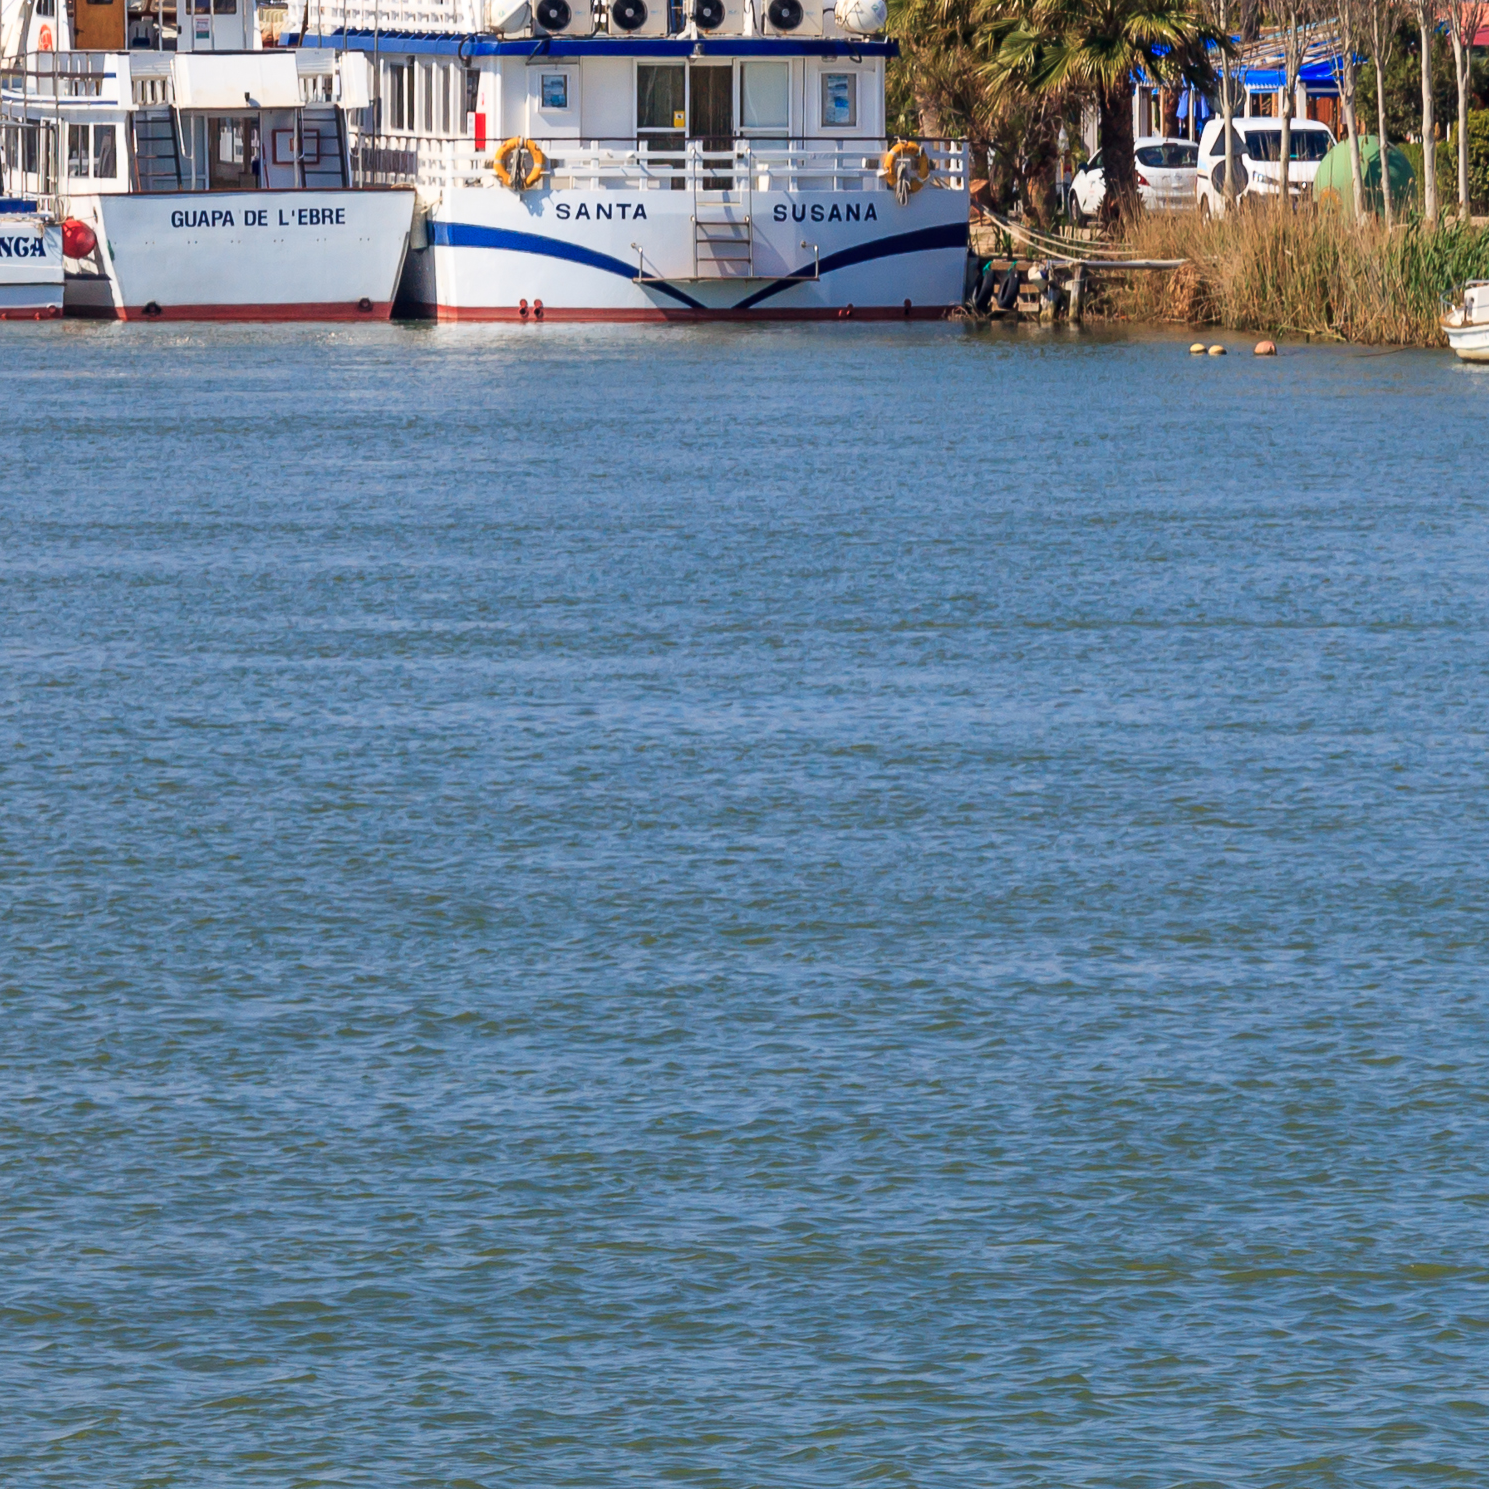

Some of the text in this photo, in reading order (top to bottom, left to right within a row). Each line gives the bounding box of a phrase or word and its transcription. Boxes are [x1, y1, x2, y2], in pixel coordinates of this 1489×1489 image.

[171, 208, 346, 228] GUAPA DE L'EBRE
[555, 202, 878, 221] SANTA SUSANA
